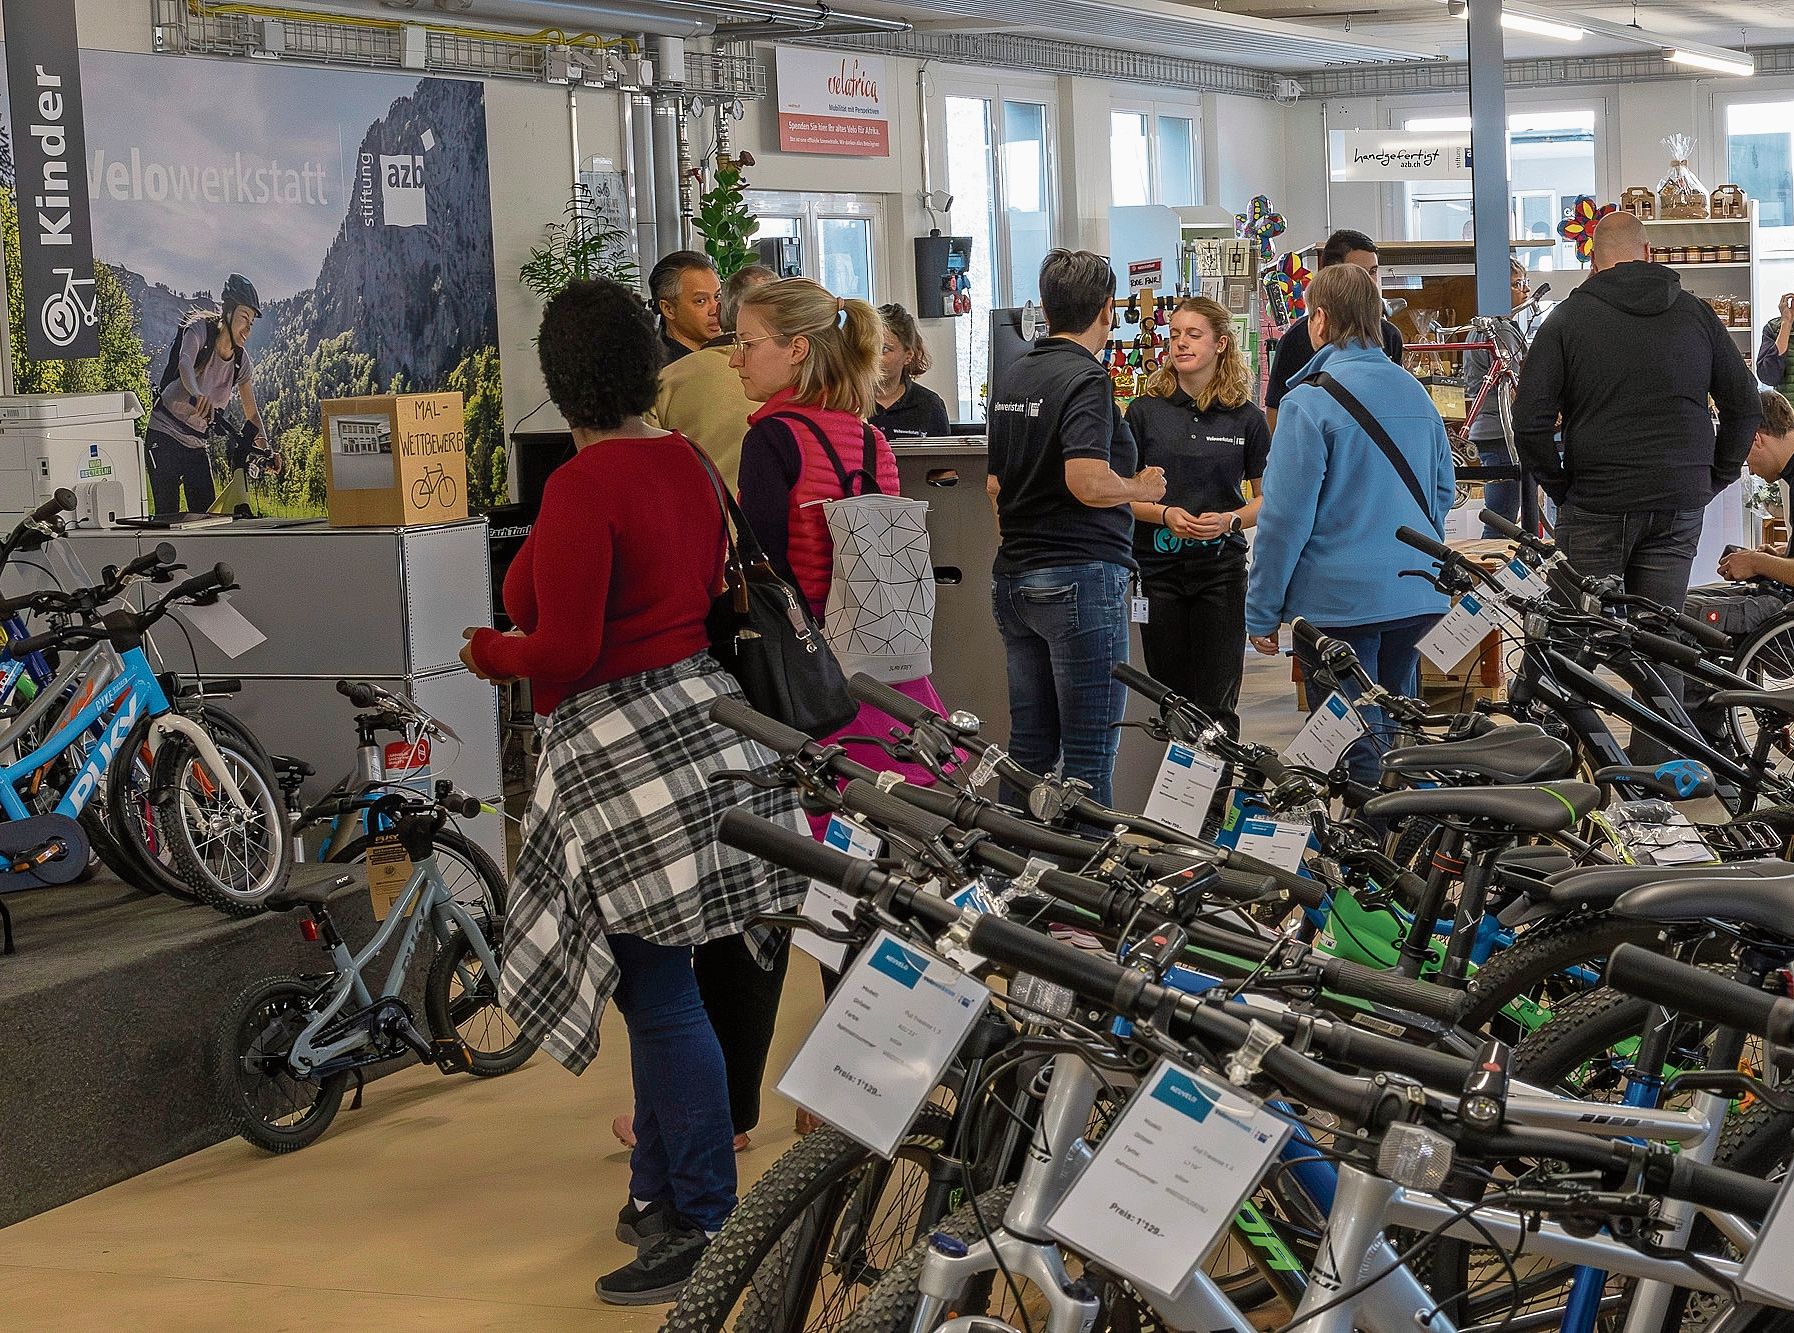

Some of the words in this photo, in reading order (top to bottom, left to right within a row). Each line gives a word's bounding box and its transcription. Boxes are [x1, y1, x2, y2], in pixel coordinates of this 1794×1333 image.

[827, 58, 879, 104] velafrica
[788, 121, 809, 132] Spenden
[810, 122, 818, 131] Sie
[835, 124, 847, 133] altes
[847, 125, 858, 134] Velo
[30, 65, 73, 246] Kinder
[1354, 147, 1440, 167] handgefertigt
[1400, 160, 1421, 168] azb.ch
[87, 146, 328, 206] Velowerkstatt
[387, 162, 425, 189] azb
[360, 153, 375, 227] stiftung
[415, 400, 449, 421] MAL-
[399, 431, 464, 457] WETTBEWERB
[832, 1063, 857, 1085] Preis:
[1107, 1200, 1138, 1223] Preis:
